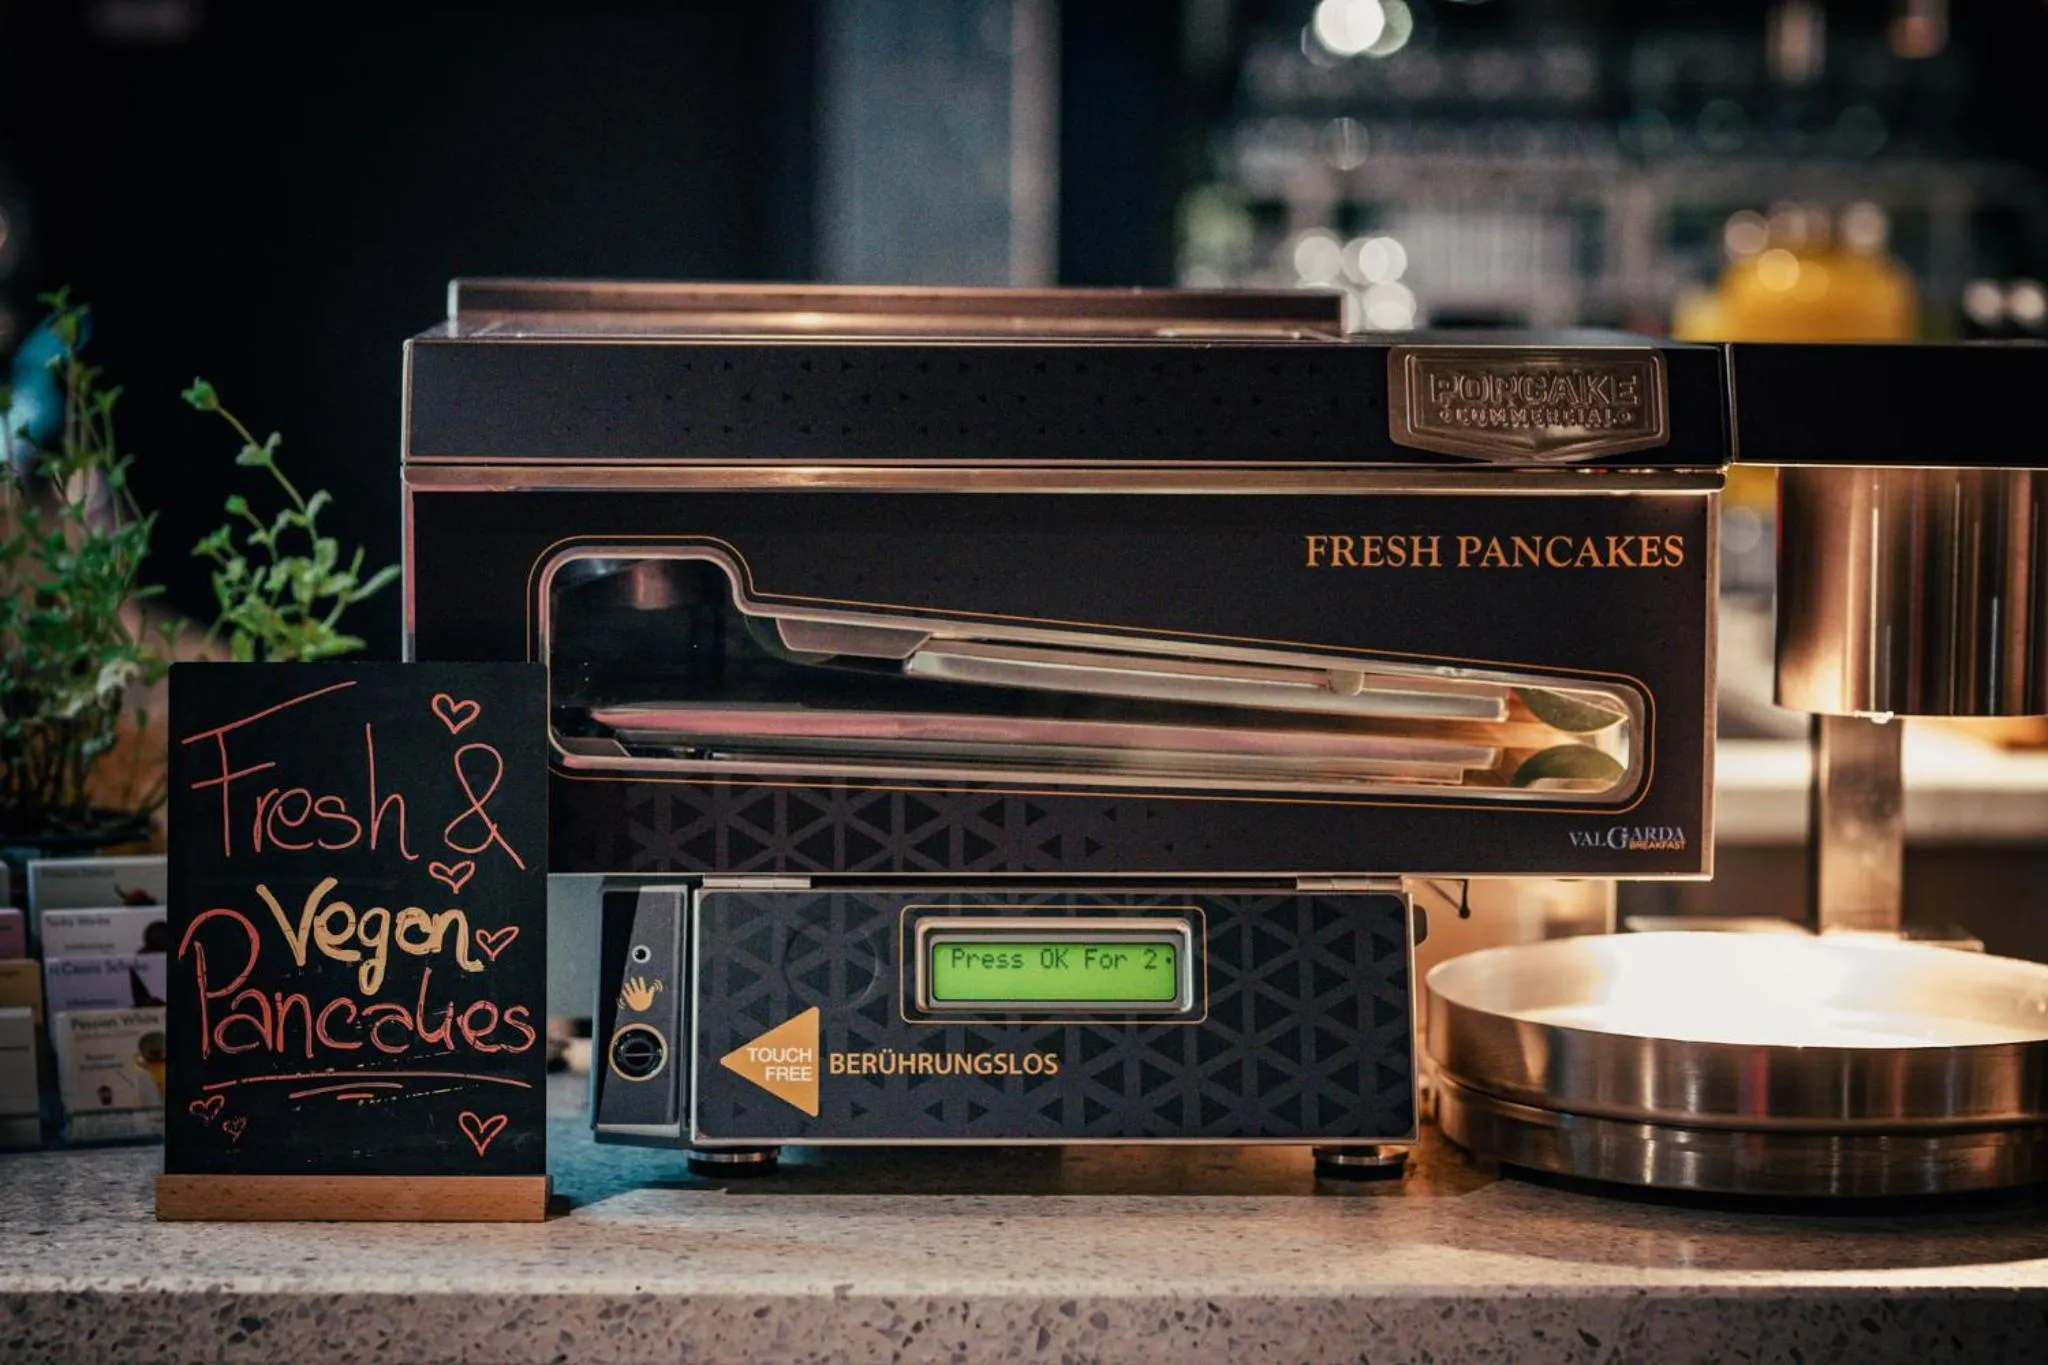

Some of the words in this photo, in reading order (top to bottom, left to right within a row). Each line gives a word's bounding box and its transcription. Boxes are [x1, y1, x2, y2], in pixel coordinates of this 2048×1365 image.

[1430, 370, 1640, 407] POPCAKE
[1455, 406, 1613, 428] COMMERCIAL
[1305, 535, 1440, 568] FRESH
[1457, 535, 1685, 569] PANCAKES
[181, 680, 419, 861] Fresh
[443, 743, 526, 870] &
[1629, 840, 1687, 851] BREAKFAST
[255, 876, 486, 997] Vegan
[951, 948, 1024, 969] Press
[1040, 948, 1068, 969] OK
[1084, 948, 1128, 969] For
[747, 1047, 813, 1063] TOUCH
[829, 1048, 1059, 1076] BERÜHRUNGSLOS
[765, 1066, 813, 1082] FREE
